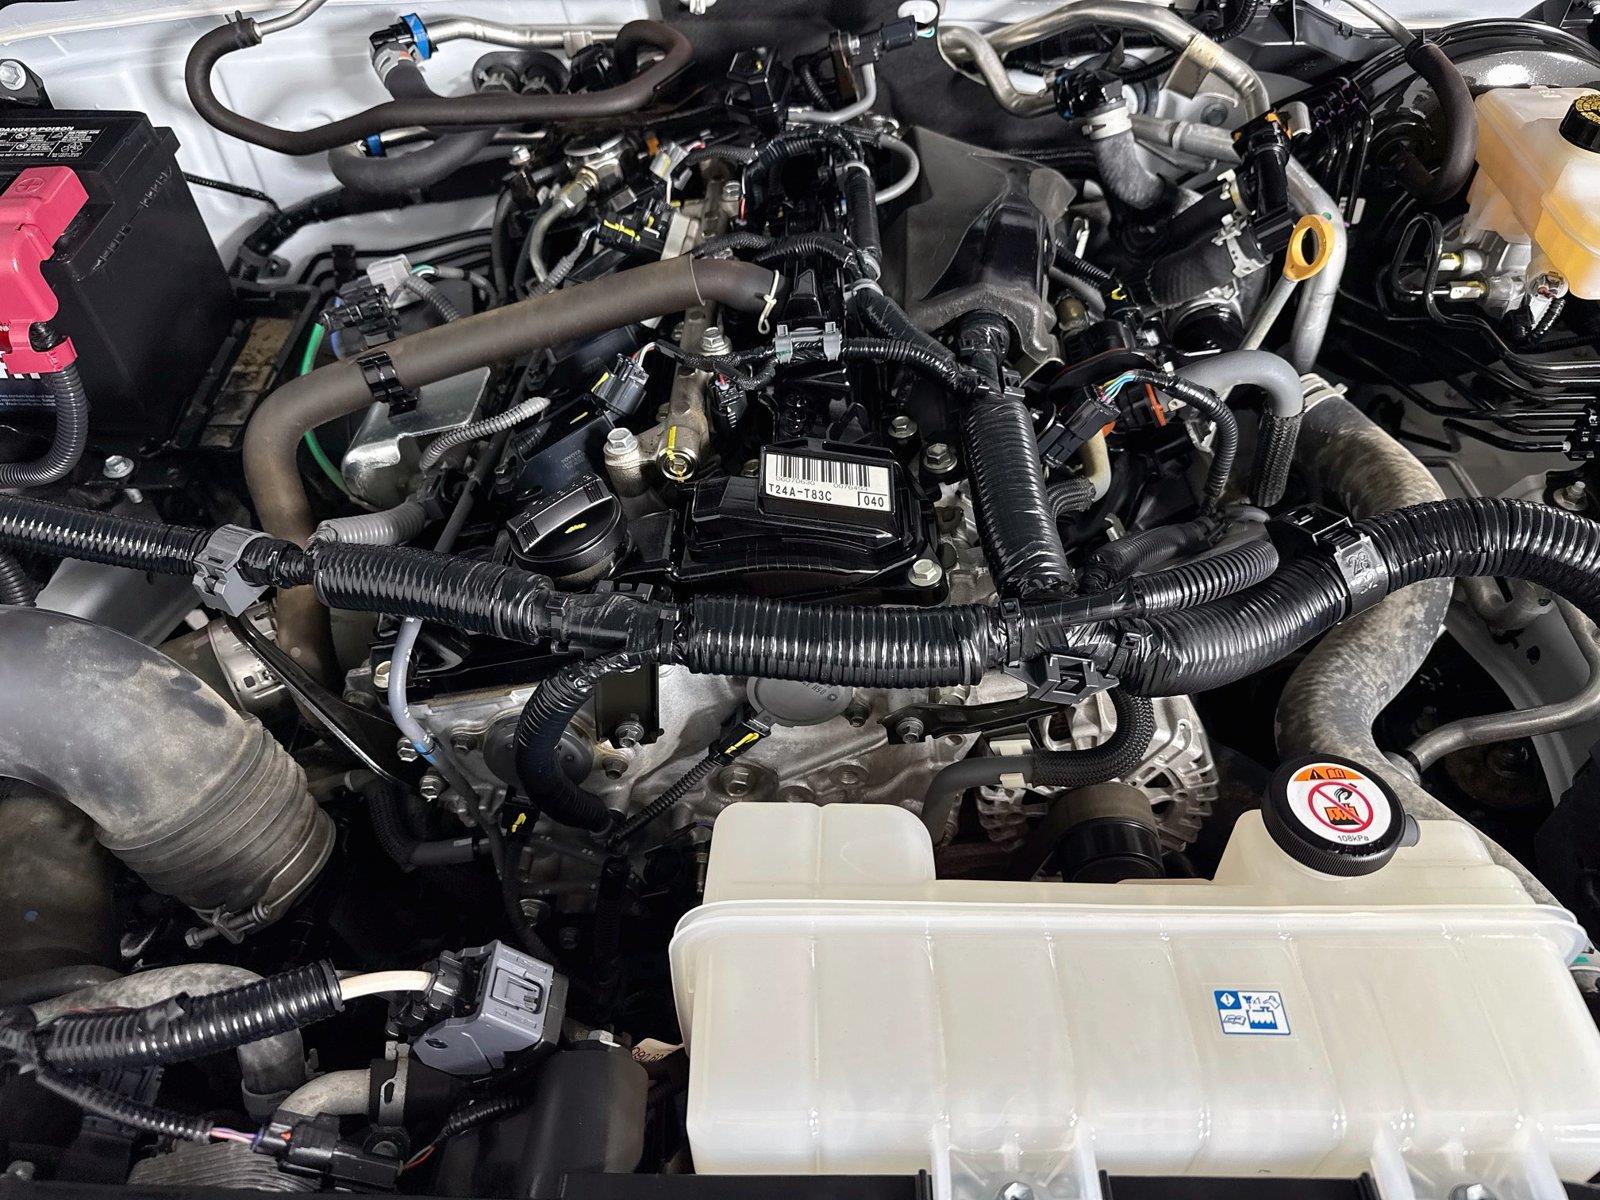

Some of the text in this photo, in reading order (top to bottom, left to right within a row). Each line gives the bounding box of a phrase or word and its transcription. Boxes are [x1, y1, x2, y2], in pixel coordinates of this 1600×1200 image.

[768, 482, 885, 508] T24A-T83C 040
[1337, 834, 1370, 843] 108kPa
